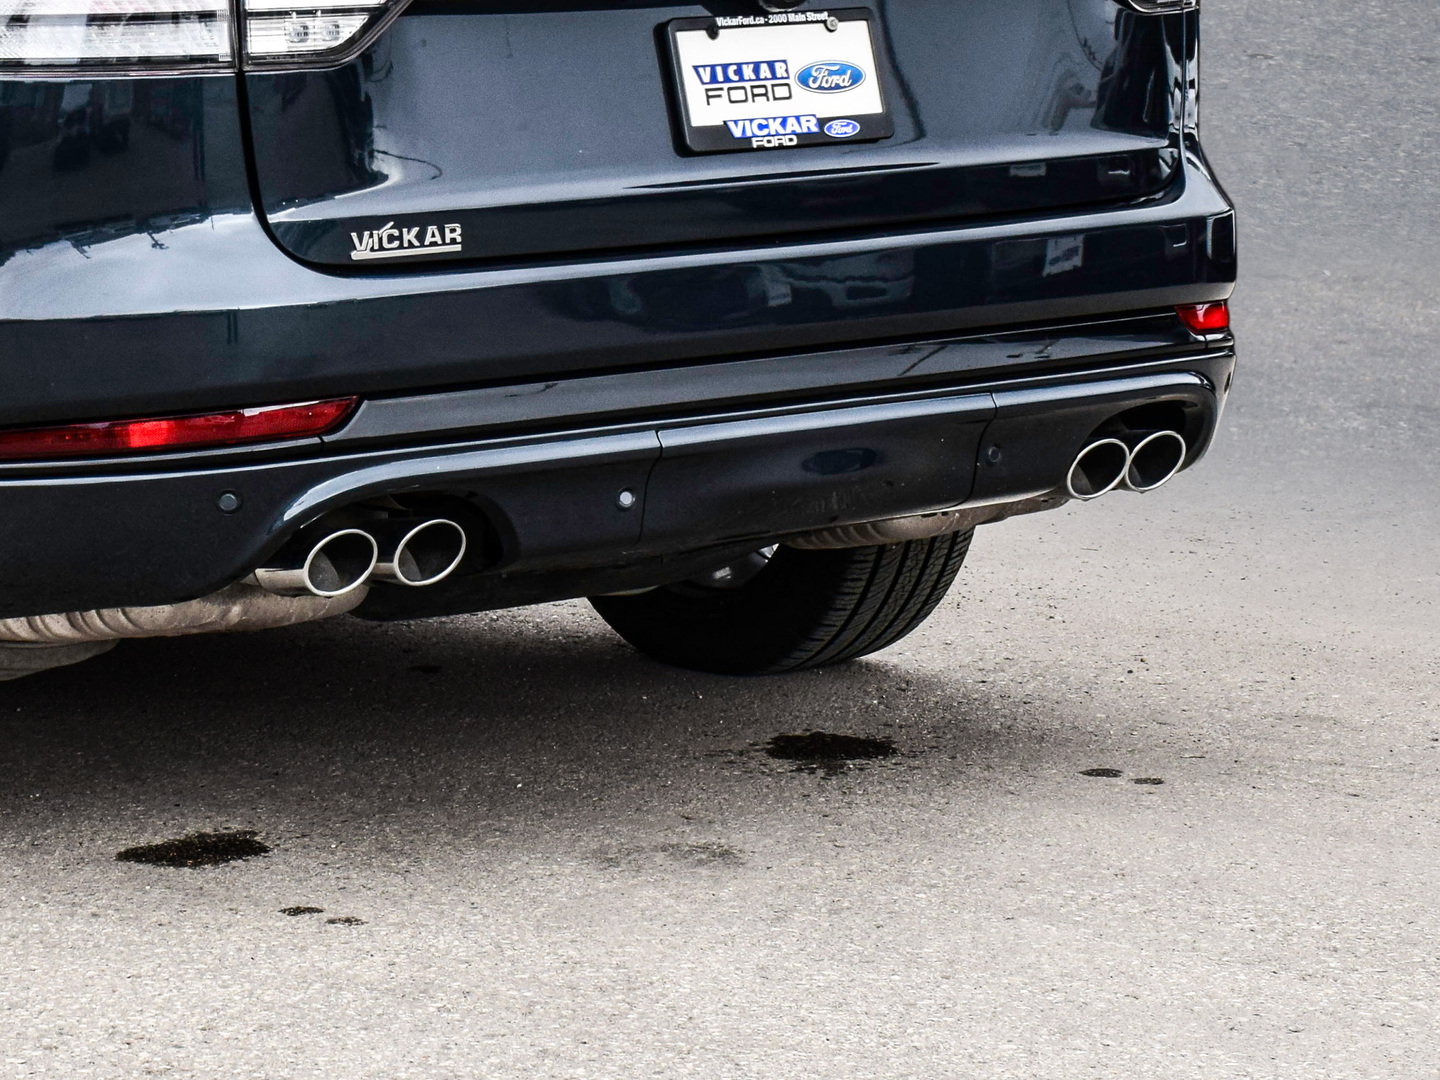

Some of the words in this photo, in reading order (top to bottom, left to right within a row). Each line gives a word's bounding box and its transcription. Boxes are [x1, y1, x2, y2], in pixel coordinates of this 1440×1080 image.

[788, 12, 806, 23] Main
[807, 11, 829, 21] Street
[697, 62, 788, 83] VICKAR
[808, 65, 853, 88] Ford
[705, 83, 792, 106] FORD
[727, 117, 820, 137] VICKAR
[751, 135, 798, 148] FORD
[350, 223, 462, 251] VICKAR
